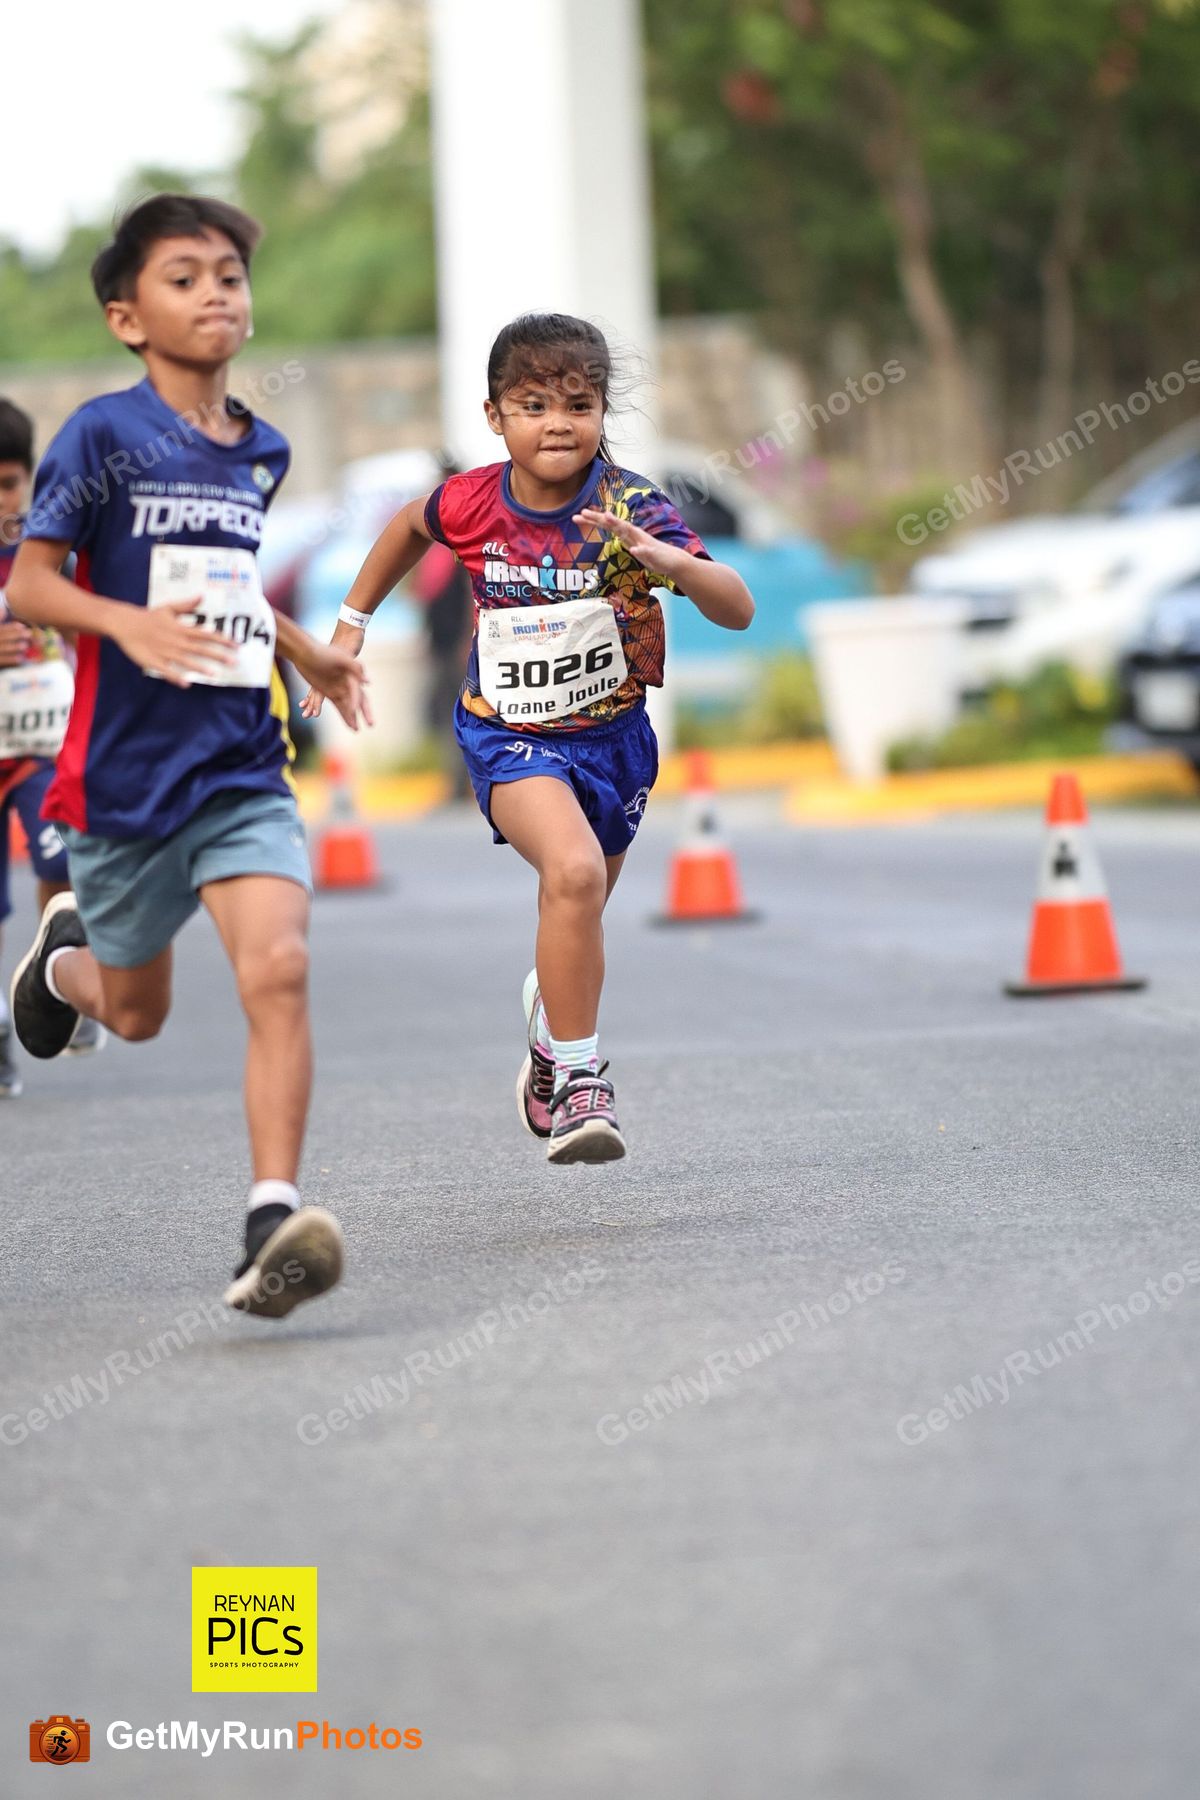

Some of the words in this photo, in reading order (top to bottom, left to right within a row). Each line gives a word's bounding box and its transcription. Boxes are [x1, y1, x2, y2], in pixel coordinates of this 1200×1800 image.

[482, 541, 510, 556] RLC
[484, 554, 599, 591] IRONKIDS
[485, 584, 533, 599] SUBIC
[512, 618, 567, 636] IRONKIDS
[496, 642, 613, 690] 3026
[497, 700, 556, 715] Loane
[565, 677, 619, 708] Joule
